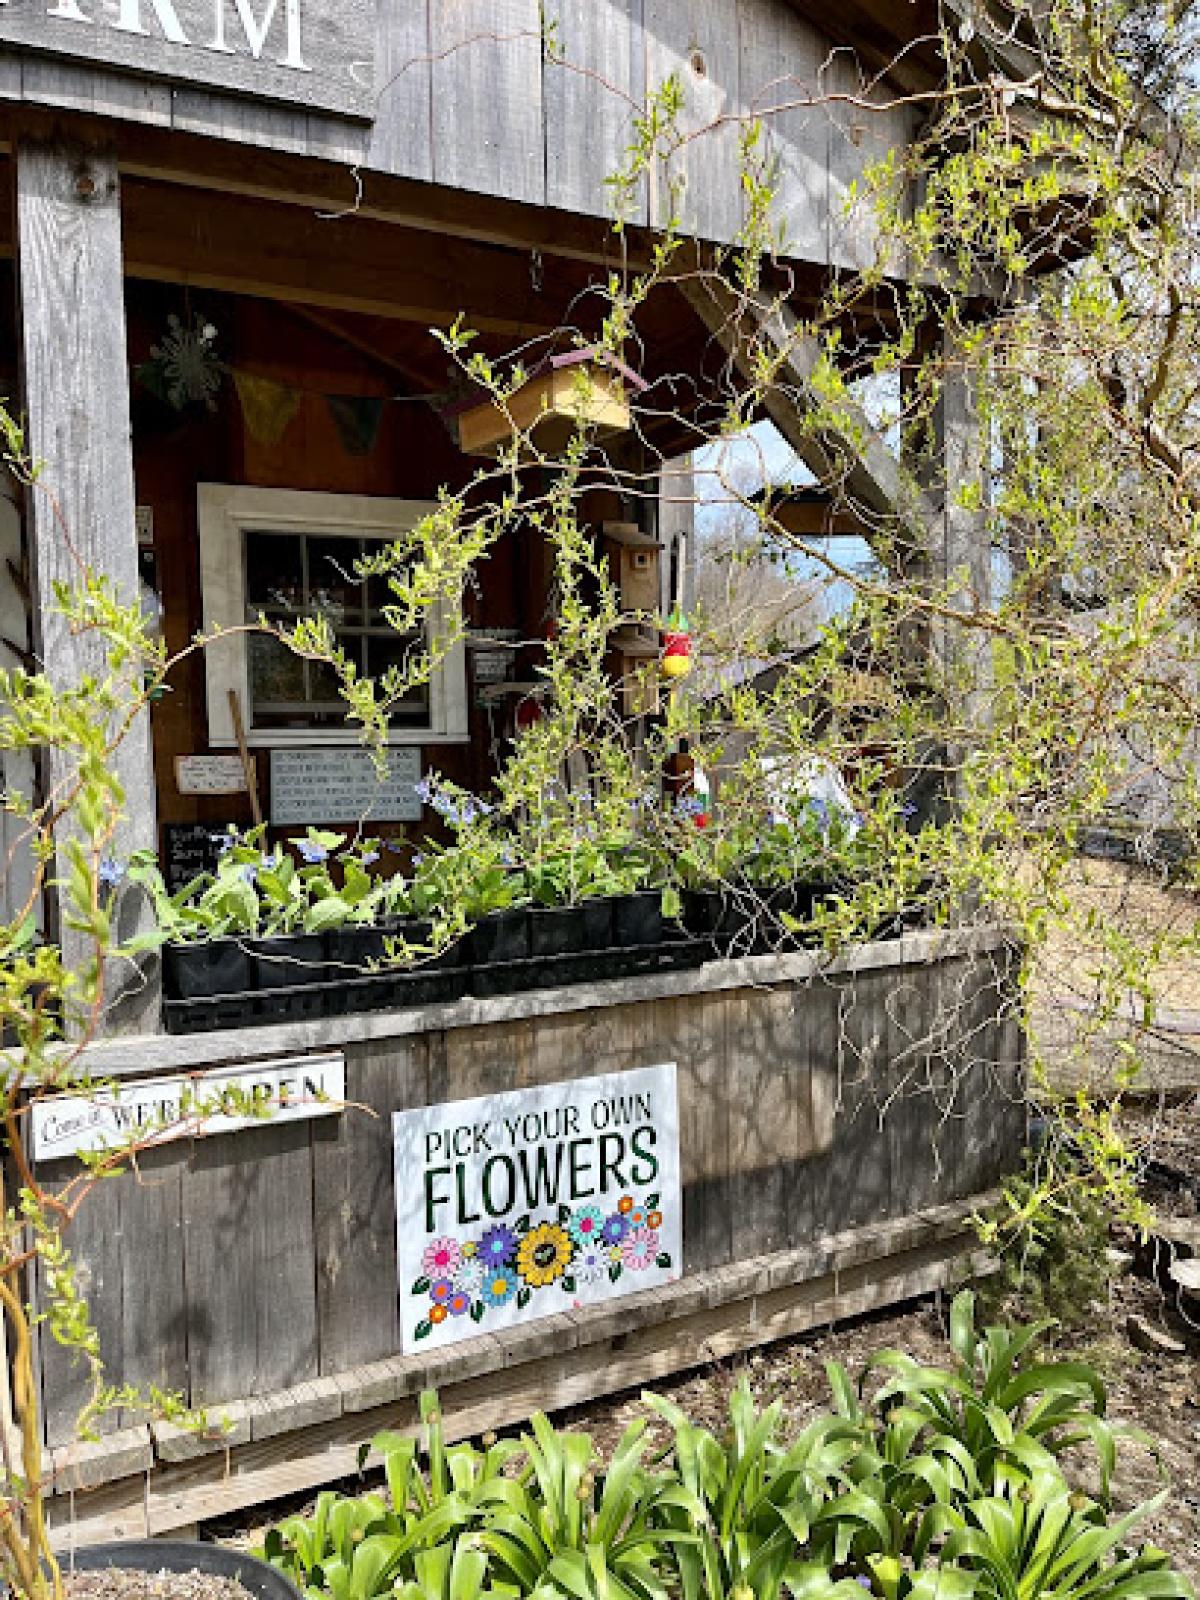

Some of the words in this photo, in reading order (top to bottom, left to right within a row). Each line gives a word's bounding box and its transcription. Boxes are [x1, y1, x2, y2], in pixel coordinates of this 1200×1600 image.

[111, 1095, 191, 1131] WE'R
[425, 1120, 492, 1163] PICK
[503, 1105, 580, 1146] YOUR
[591, 1091, 651, 1131] OWN
[424, 1126, 660, 1233] FLOWERS
